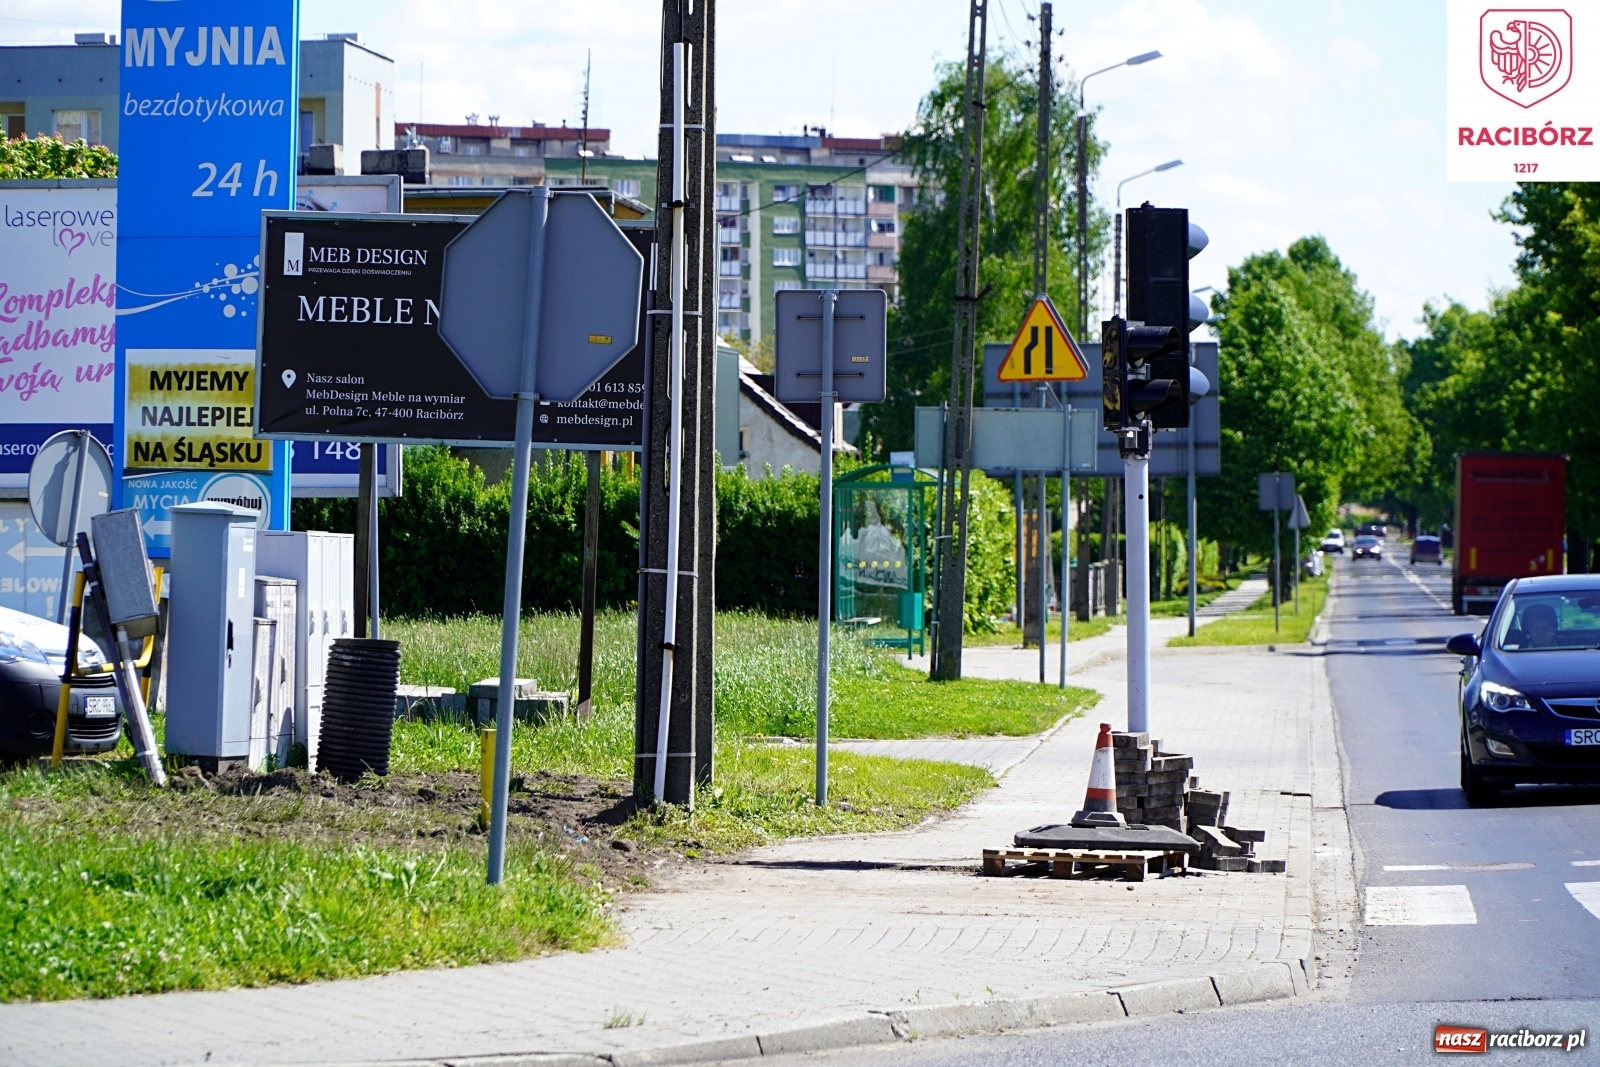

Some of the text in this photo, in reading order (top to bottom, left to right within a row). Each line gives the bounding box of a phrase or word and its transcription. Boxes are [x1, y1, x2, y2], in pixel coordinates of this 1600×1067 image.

[125, 26, 286, 67] MYJNIA
[124, 92, 284, 123] bezdotykowa
[192, 160, 278, 197] 24 h
[5, 204, 114, 227] laserowe
[308, 247, 428, 265] MEB DESIGN
[287, 259, 300, 272] M
[362, 267, 412, 276] DOŚWIADCZENIU
[297, 295, 414, 325] MEBLE
[149, 370, 250, 392] MYJEMY
[306, 373, 365, 385] Nasz salon
[604, 383, 625, 393] 613
[306, 389, 466, 405] MebDesign Meble na wymiar
[141, 406, 254, 427] NAJLEPIEJ
[305, 406, 319, 416] ul.
[322, 406, 353, 417] Polna
[374, 408, 413, 418] 47-400
[416, 409, 464, 420] Racibórz
[556, 414, 633, 428] mebdesign.pl
[133, 441, 167, 462] NA
[173, 437, 262, 467] ŚLĄSKU
[128, 479, 198, 490] NOWA JAKOŚĆ
